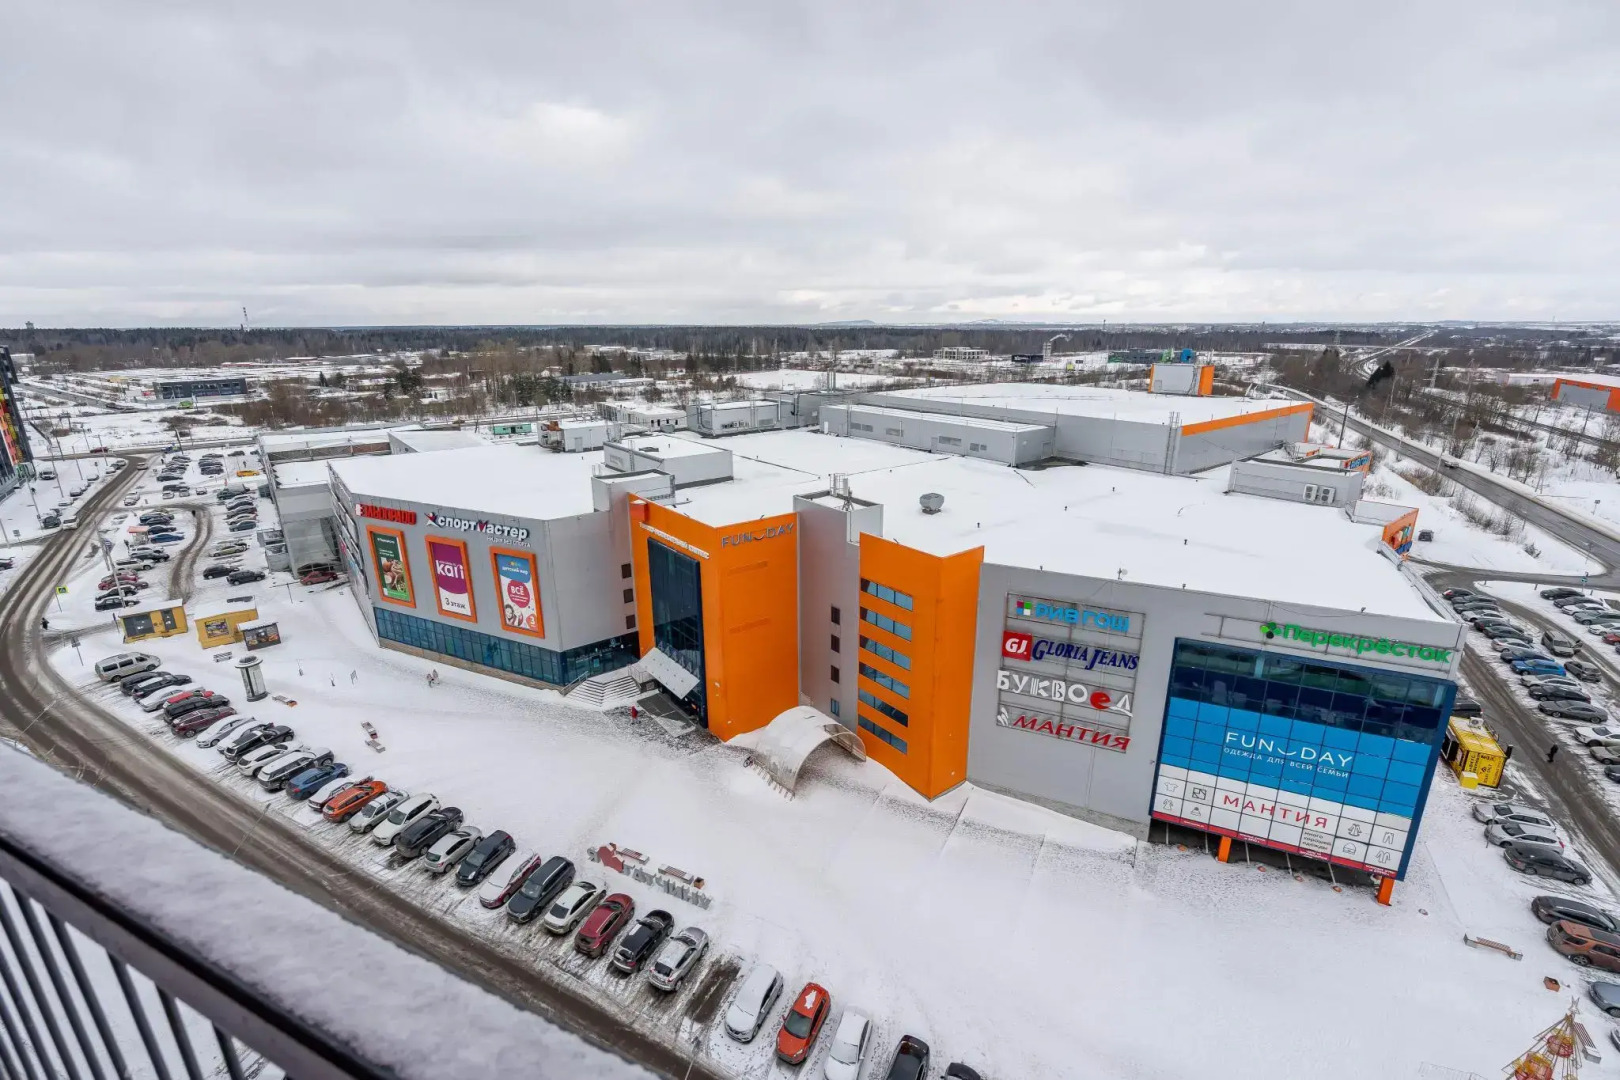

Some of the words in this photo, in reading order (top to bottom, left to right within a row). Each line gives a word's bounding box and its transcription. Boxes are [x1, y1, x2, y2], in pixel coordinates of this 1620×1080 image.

[721, 535, 752, 548] FUN
[766, 522, 795, 539] DAY
[435, 560, 464, 579] kari
[1283, 624, 1452, 664] Перекрёсток
[1013, 715, 1131, 751] МАНТИЯ
[1225, 731, 1274, 752] FUN
[1300, 747, 1353, 767] DAY
[1223, 746, 1262, 760] ОДЕЖДА
[1267, 756, 1285, 765] ДЛЯ
[1290, 761, 1313, 771] ВСЕЙ
[1317, 765, 1350, 779] СЕМЬИ
[1222, 794, 1329, 829] МАНТИЯ
